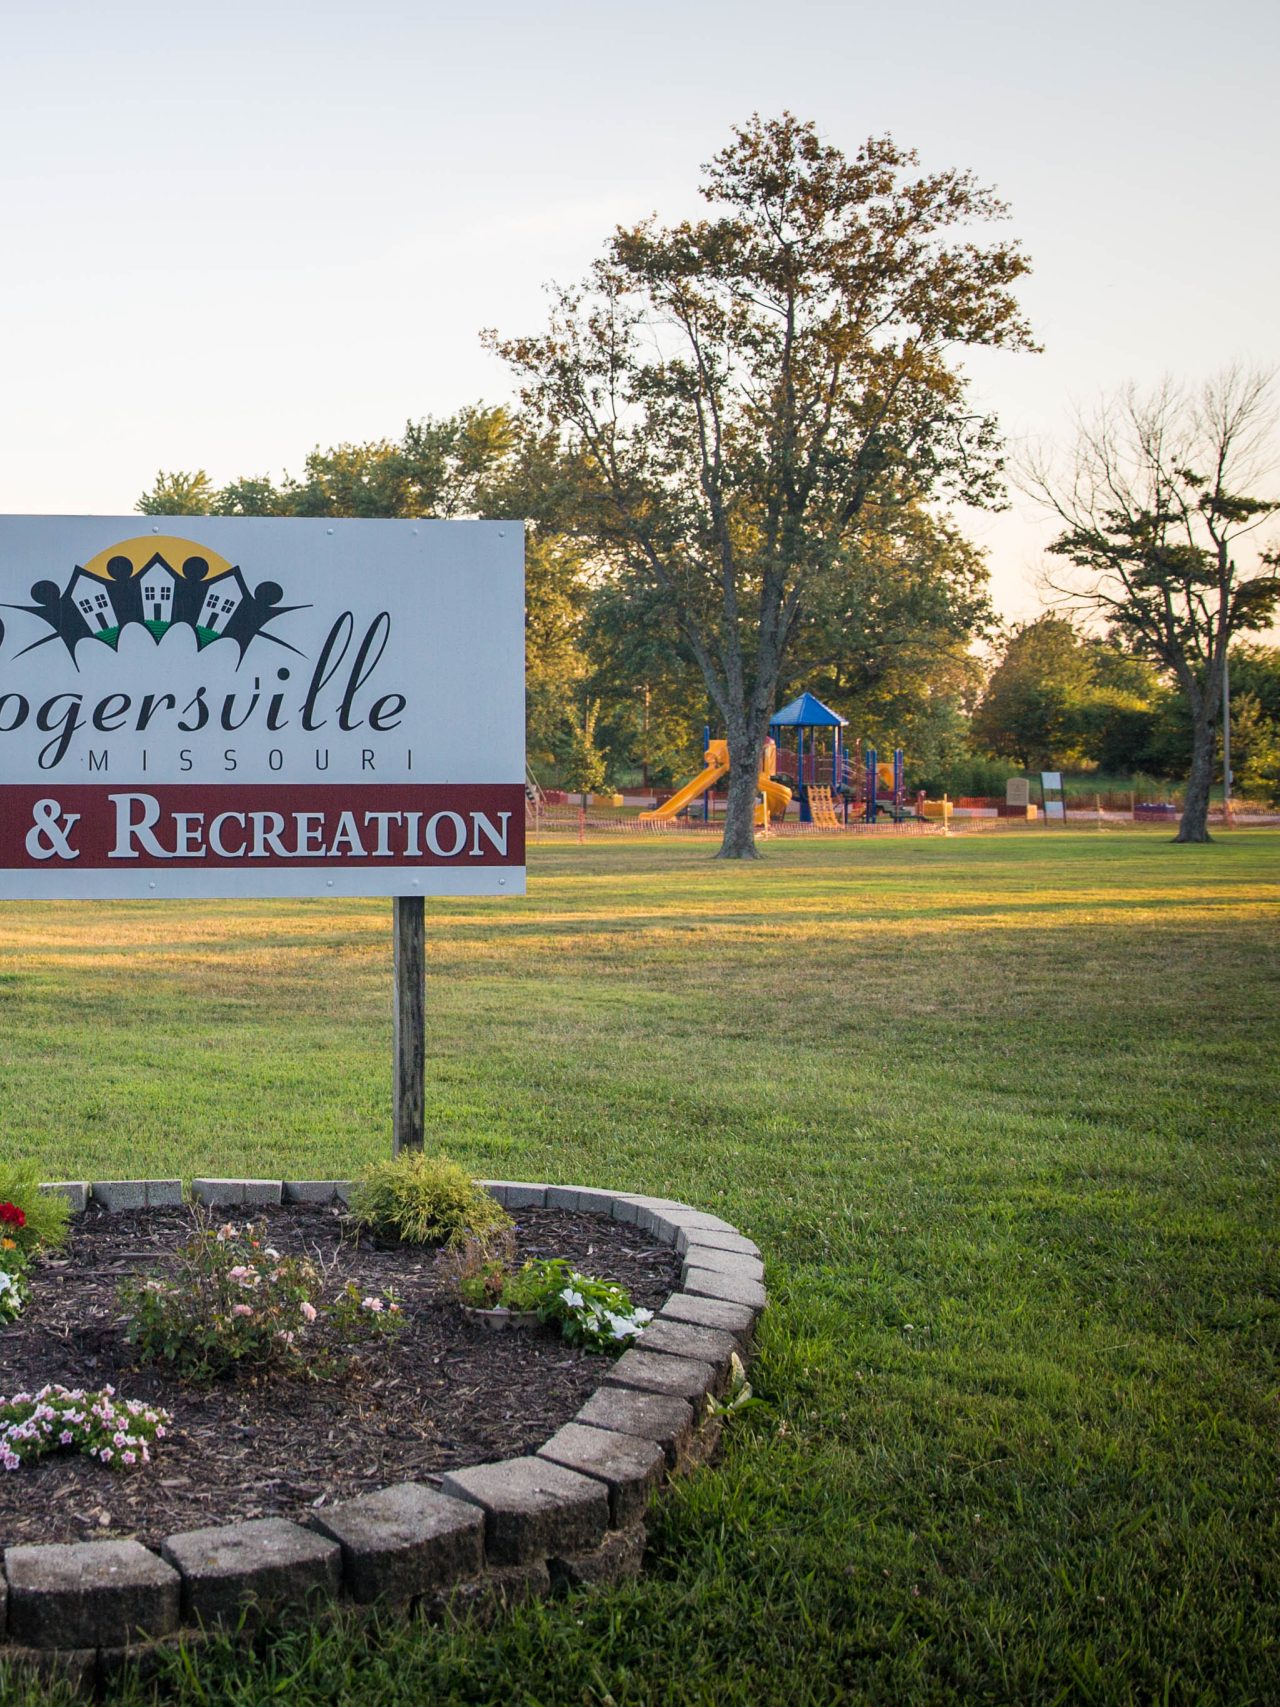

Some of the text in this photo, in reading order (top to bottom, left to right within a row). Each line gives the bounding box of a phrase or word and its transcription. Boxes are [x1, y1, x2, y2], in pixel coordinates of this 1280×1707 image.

[87, 749, 413, 772] MISSOURI
[25, 798, 81, 861] &
[108, 792, 512, 860] RECREATION
